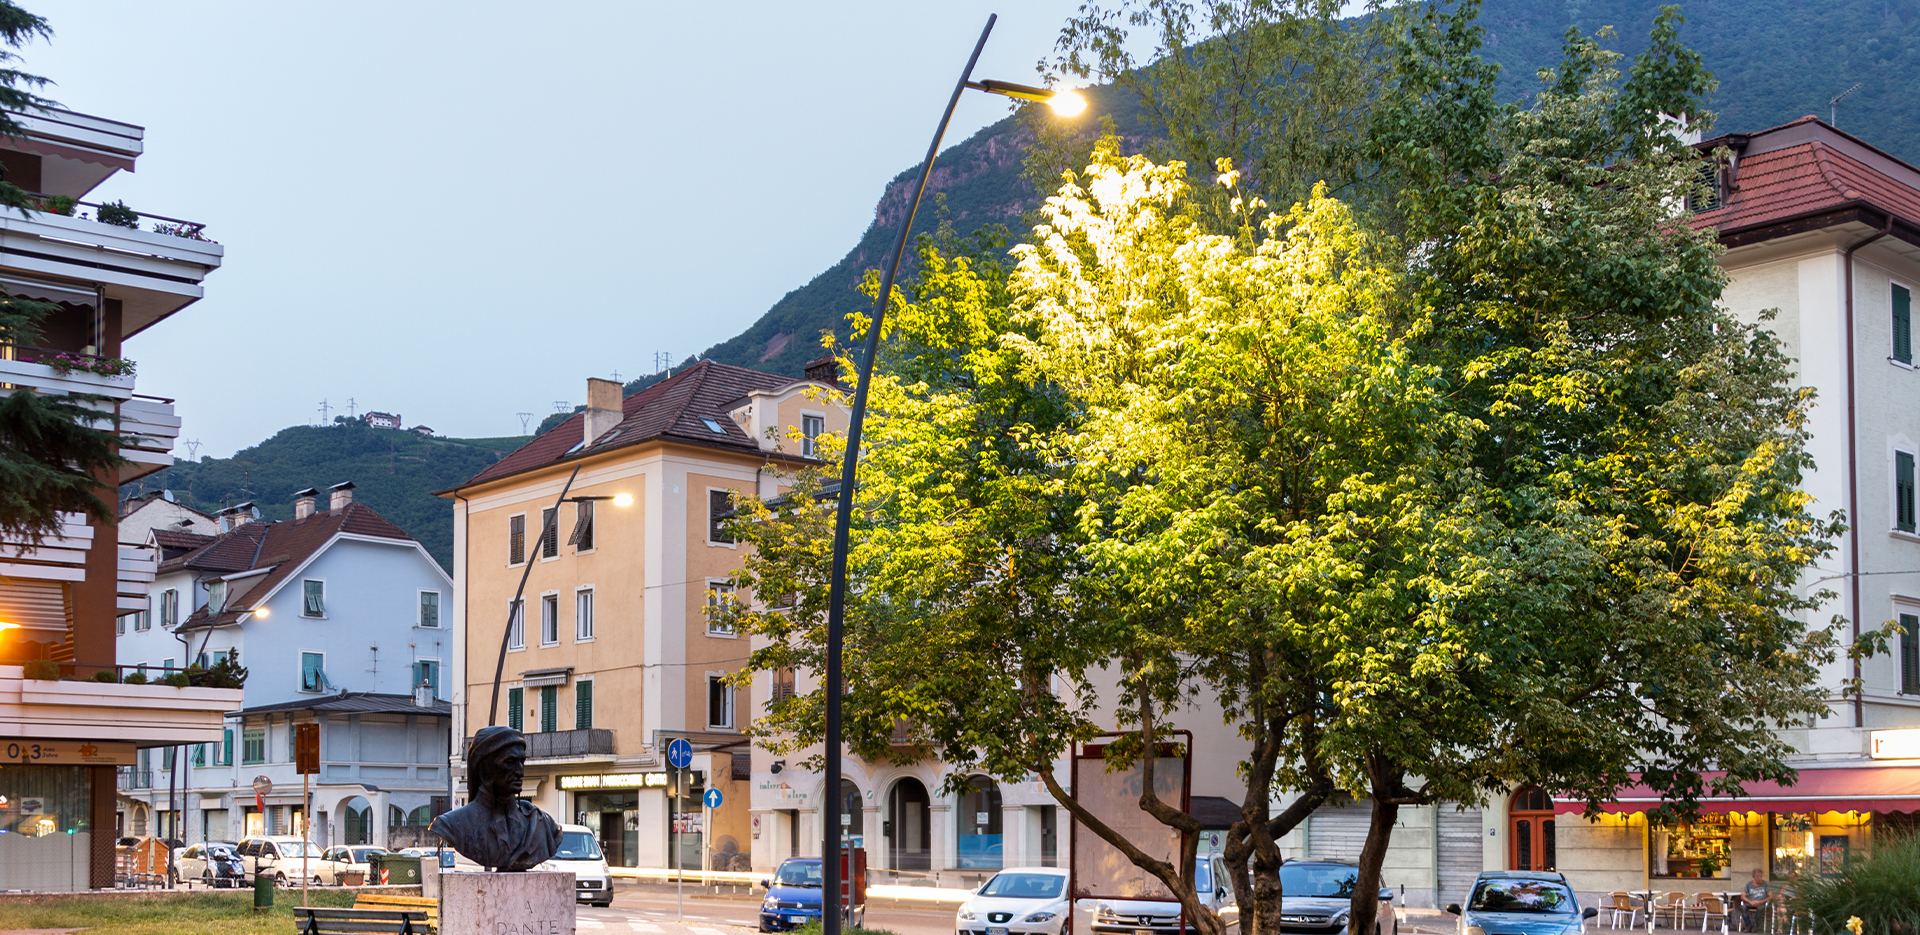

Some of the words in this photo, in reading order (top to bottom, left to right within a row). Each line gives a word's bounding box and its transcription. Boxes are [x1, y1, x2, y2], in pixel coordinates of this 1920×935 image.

[30, 744, 42, 759] 3
[524, 900, 533, 914] A
[496, 919, 560, 935] DANTE
